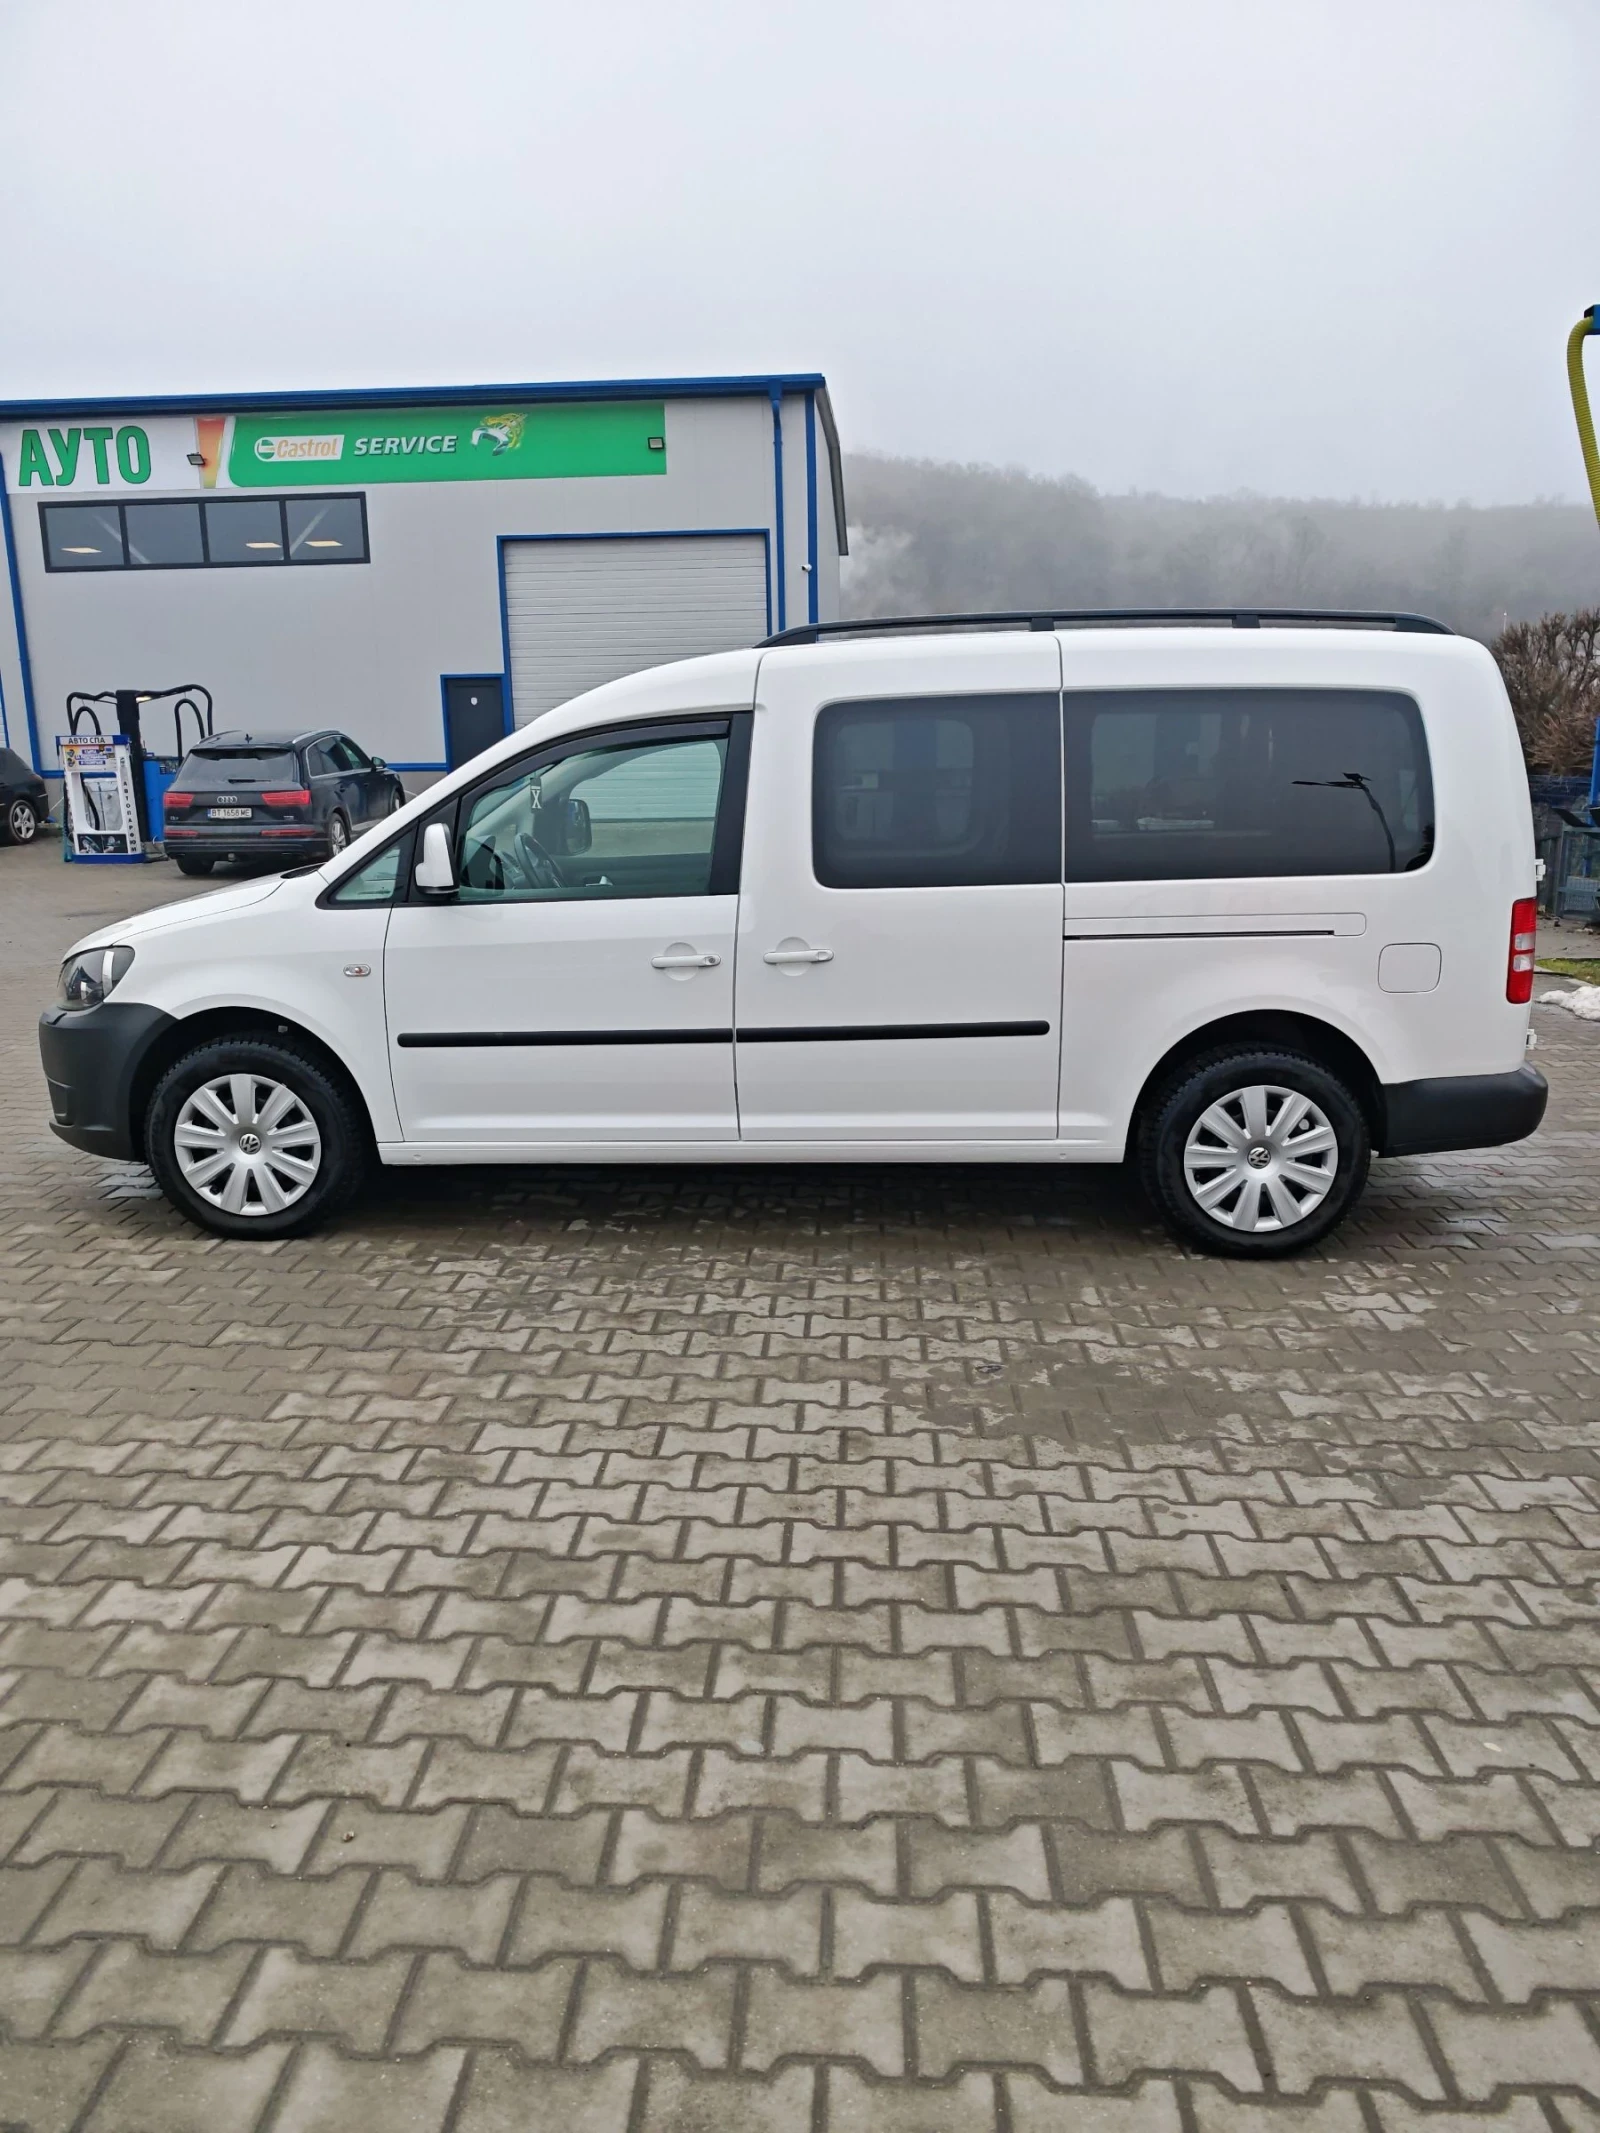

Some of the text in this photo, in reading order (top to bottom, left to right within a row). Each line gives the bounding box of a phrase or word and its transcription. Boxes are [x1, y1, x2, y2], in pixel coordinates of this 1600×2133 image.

[19, 426, 151, 486] АУТО
[277, 436, 458, 458] Castrol SERVICE
